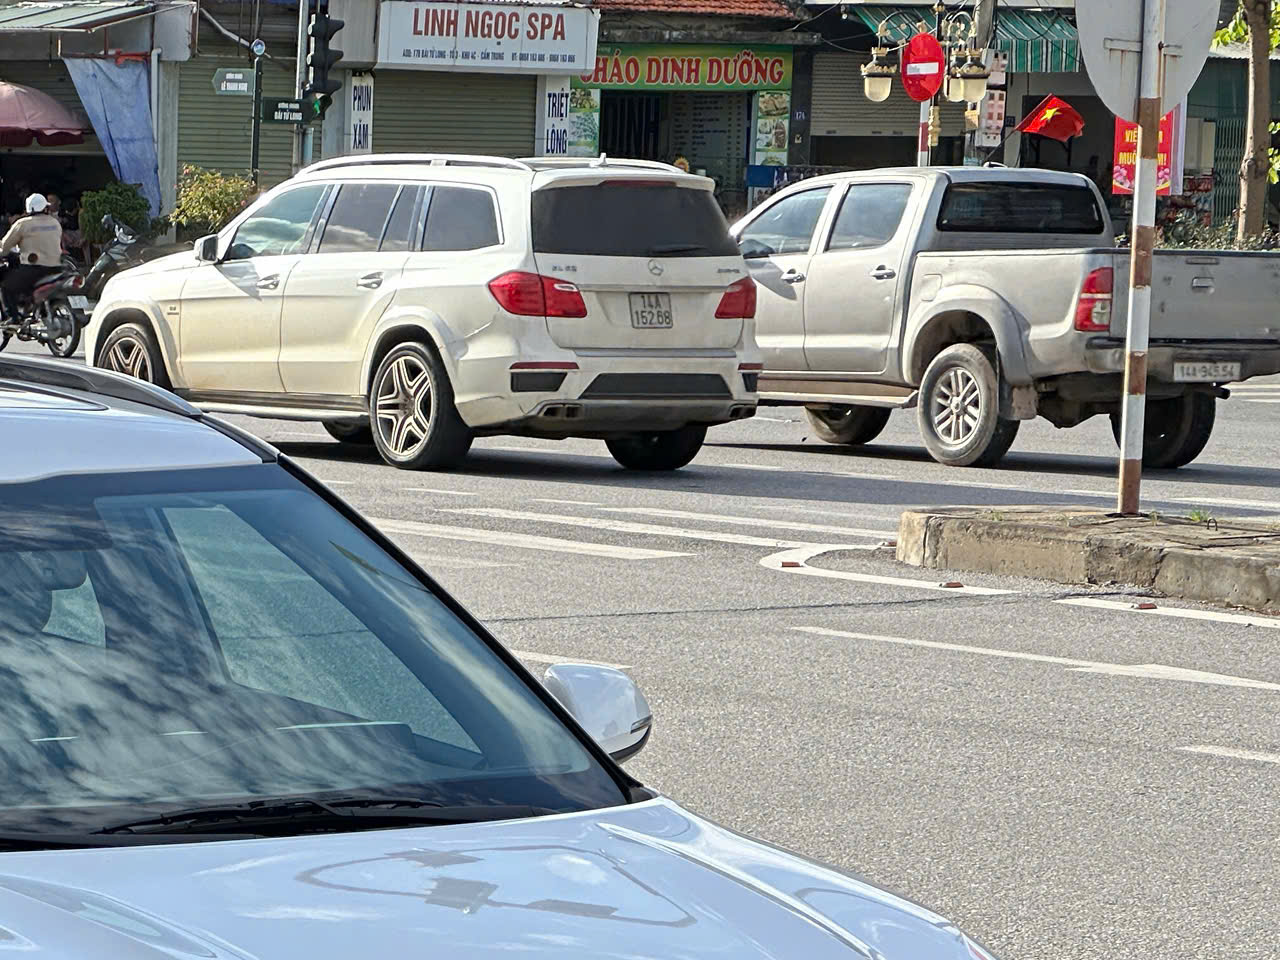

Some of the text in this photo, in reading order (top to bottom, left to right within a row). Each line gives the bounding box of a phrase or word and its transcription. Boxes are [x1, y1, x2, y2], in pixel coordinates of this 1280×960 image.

[413, 8, 566, 46] LINH NGỌC SPA
[581, 48, 785, 85] HÁO DINH DƯỠNG
[353, 85, 371, 112] PHUN
[547, 88, 569, 121] TRIỆT
[546, 123, 568, 154] LÔNG
[640, 293, 662, 309] 14A
